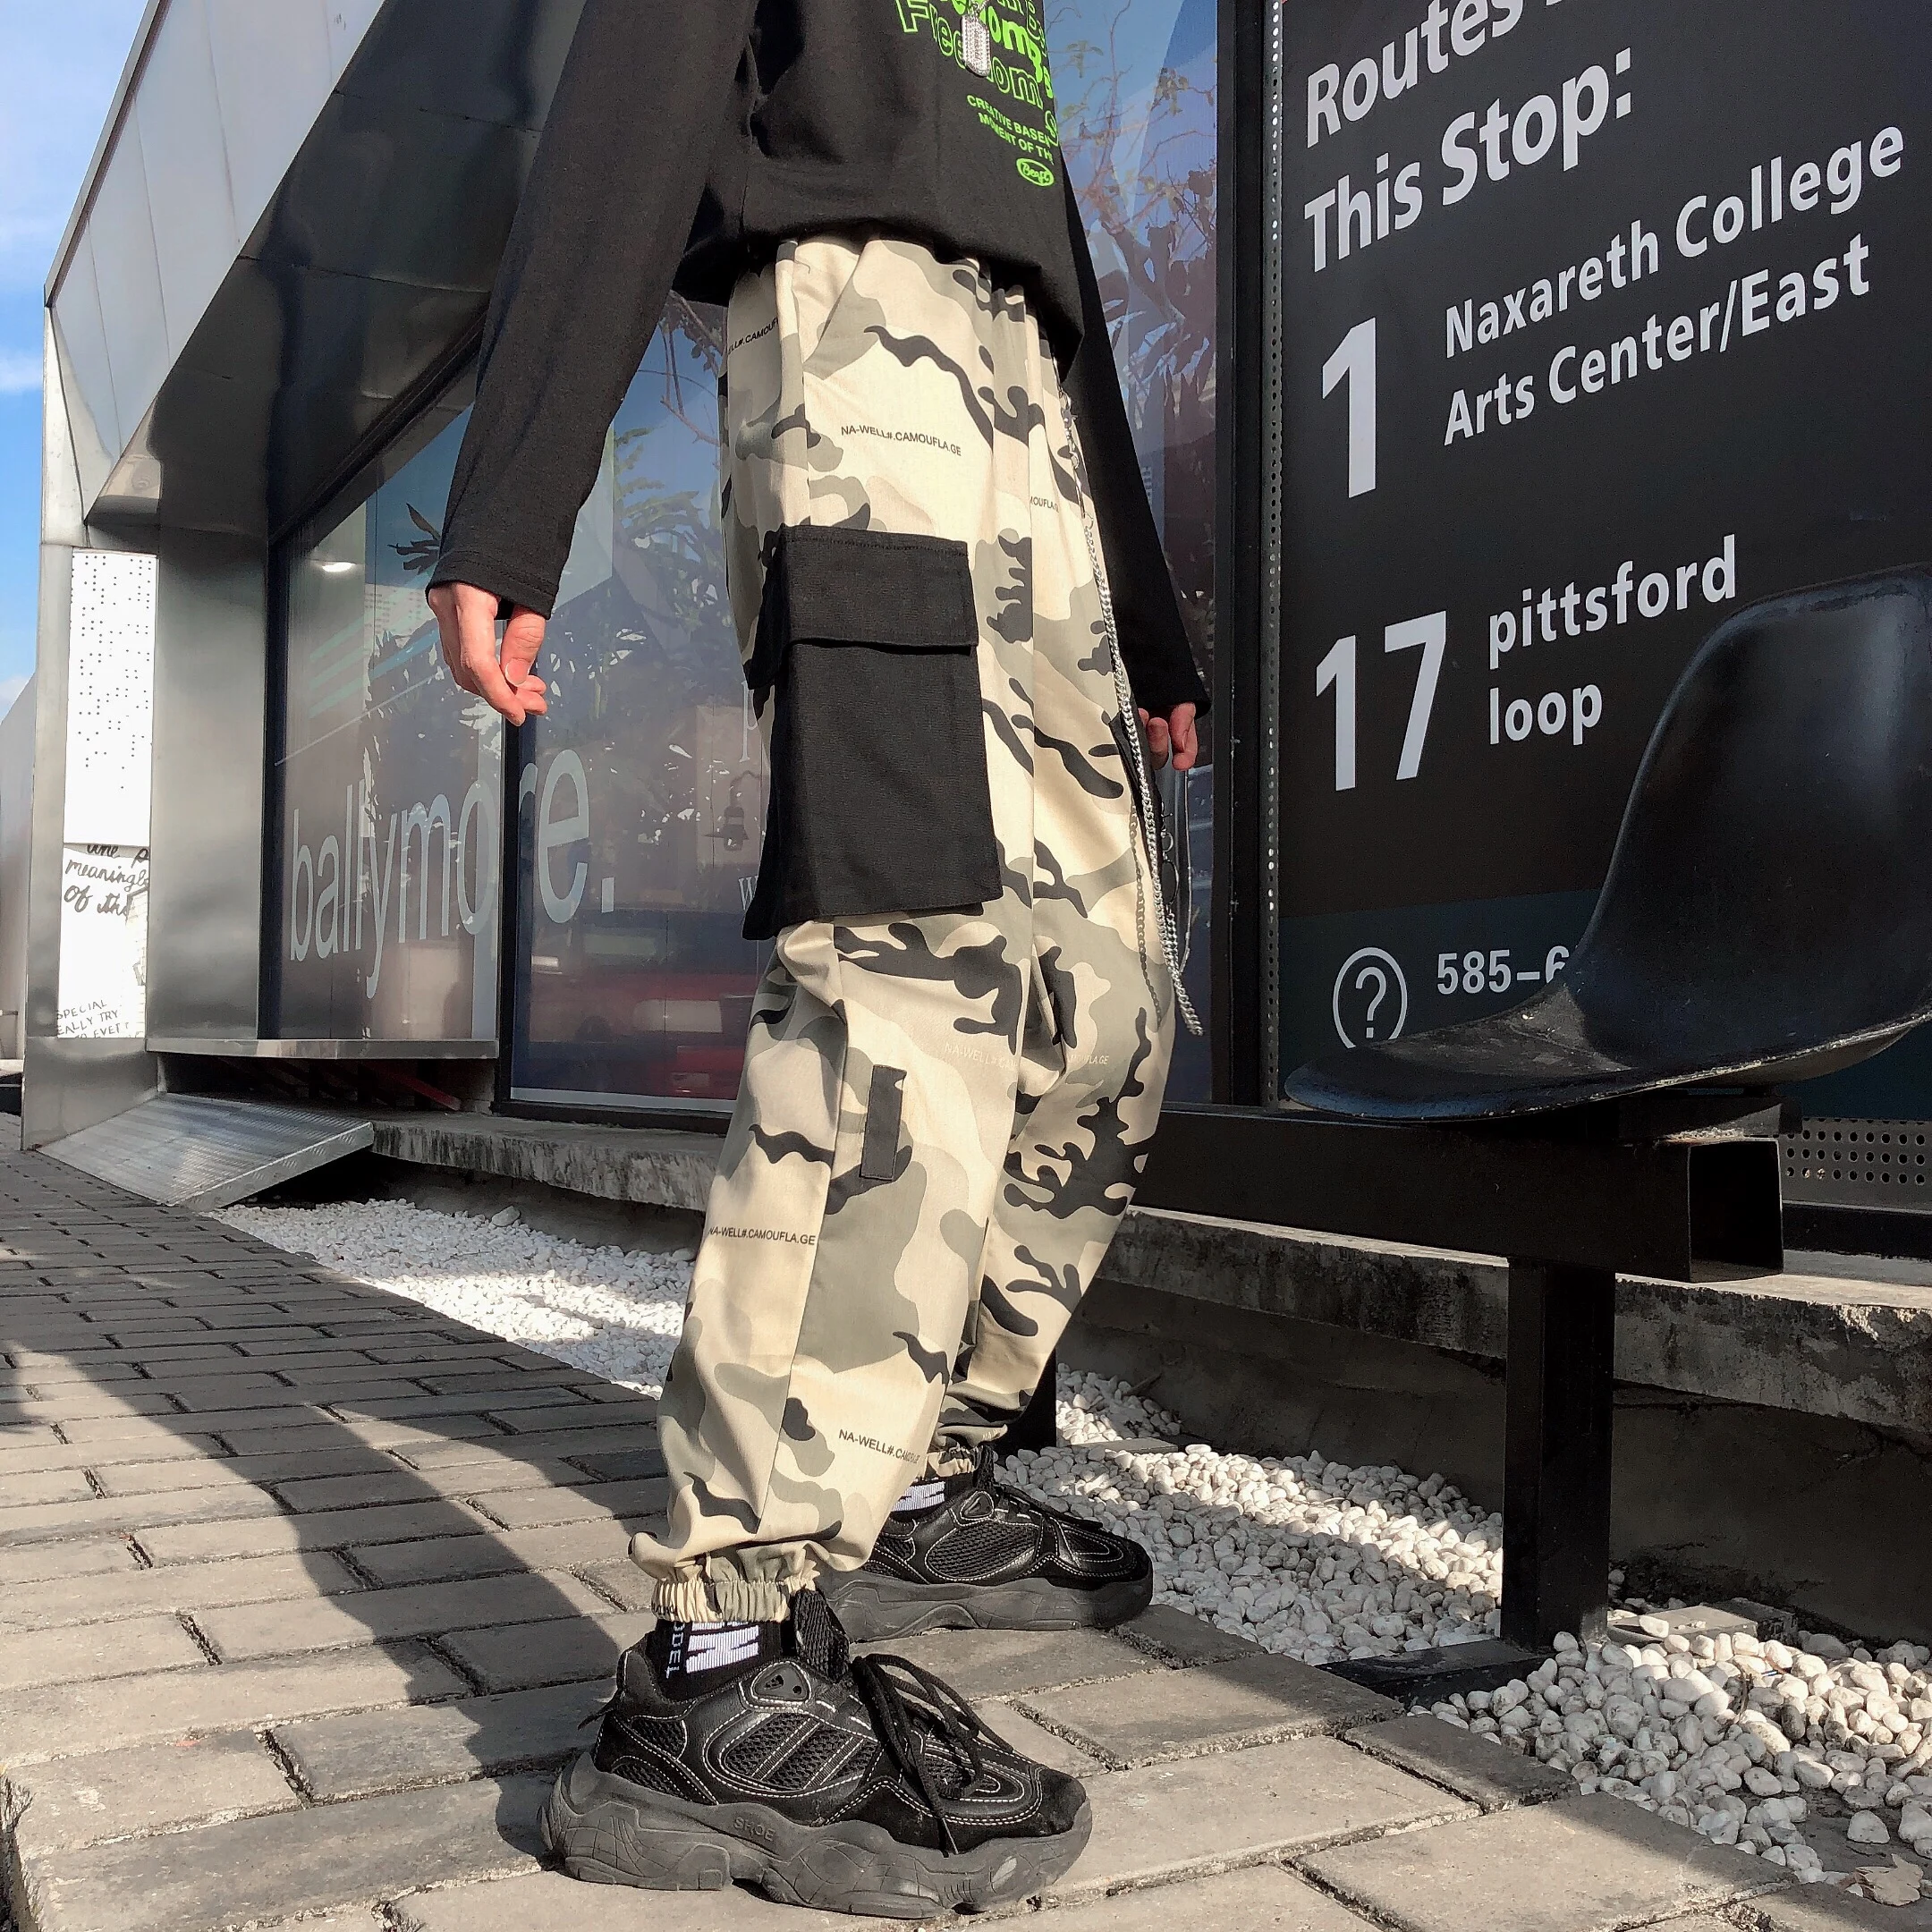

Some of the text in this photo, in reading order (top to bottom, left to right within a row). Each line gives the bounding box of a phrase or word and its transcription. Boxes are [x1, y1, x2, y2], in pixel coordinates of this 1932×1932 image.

[1018, 138, 1035, 153] OF
[1304, 47, 1631, 273] This Stop:
[1306, 0, 1522, 148] Routes
[1444, 233, 1870, 446] Arts Center/East
[1445, 125, 1904, 359] Naxareth College
[1322, 317, 1377, 499] 1
[1316, 533, 1736, 792] 17 pittsford
[1488, 682, 1604, 746] loop
